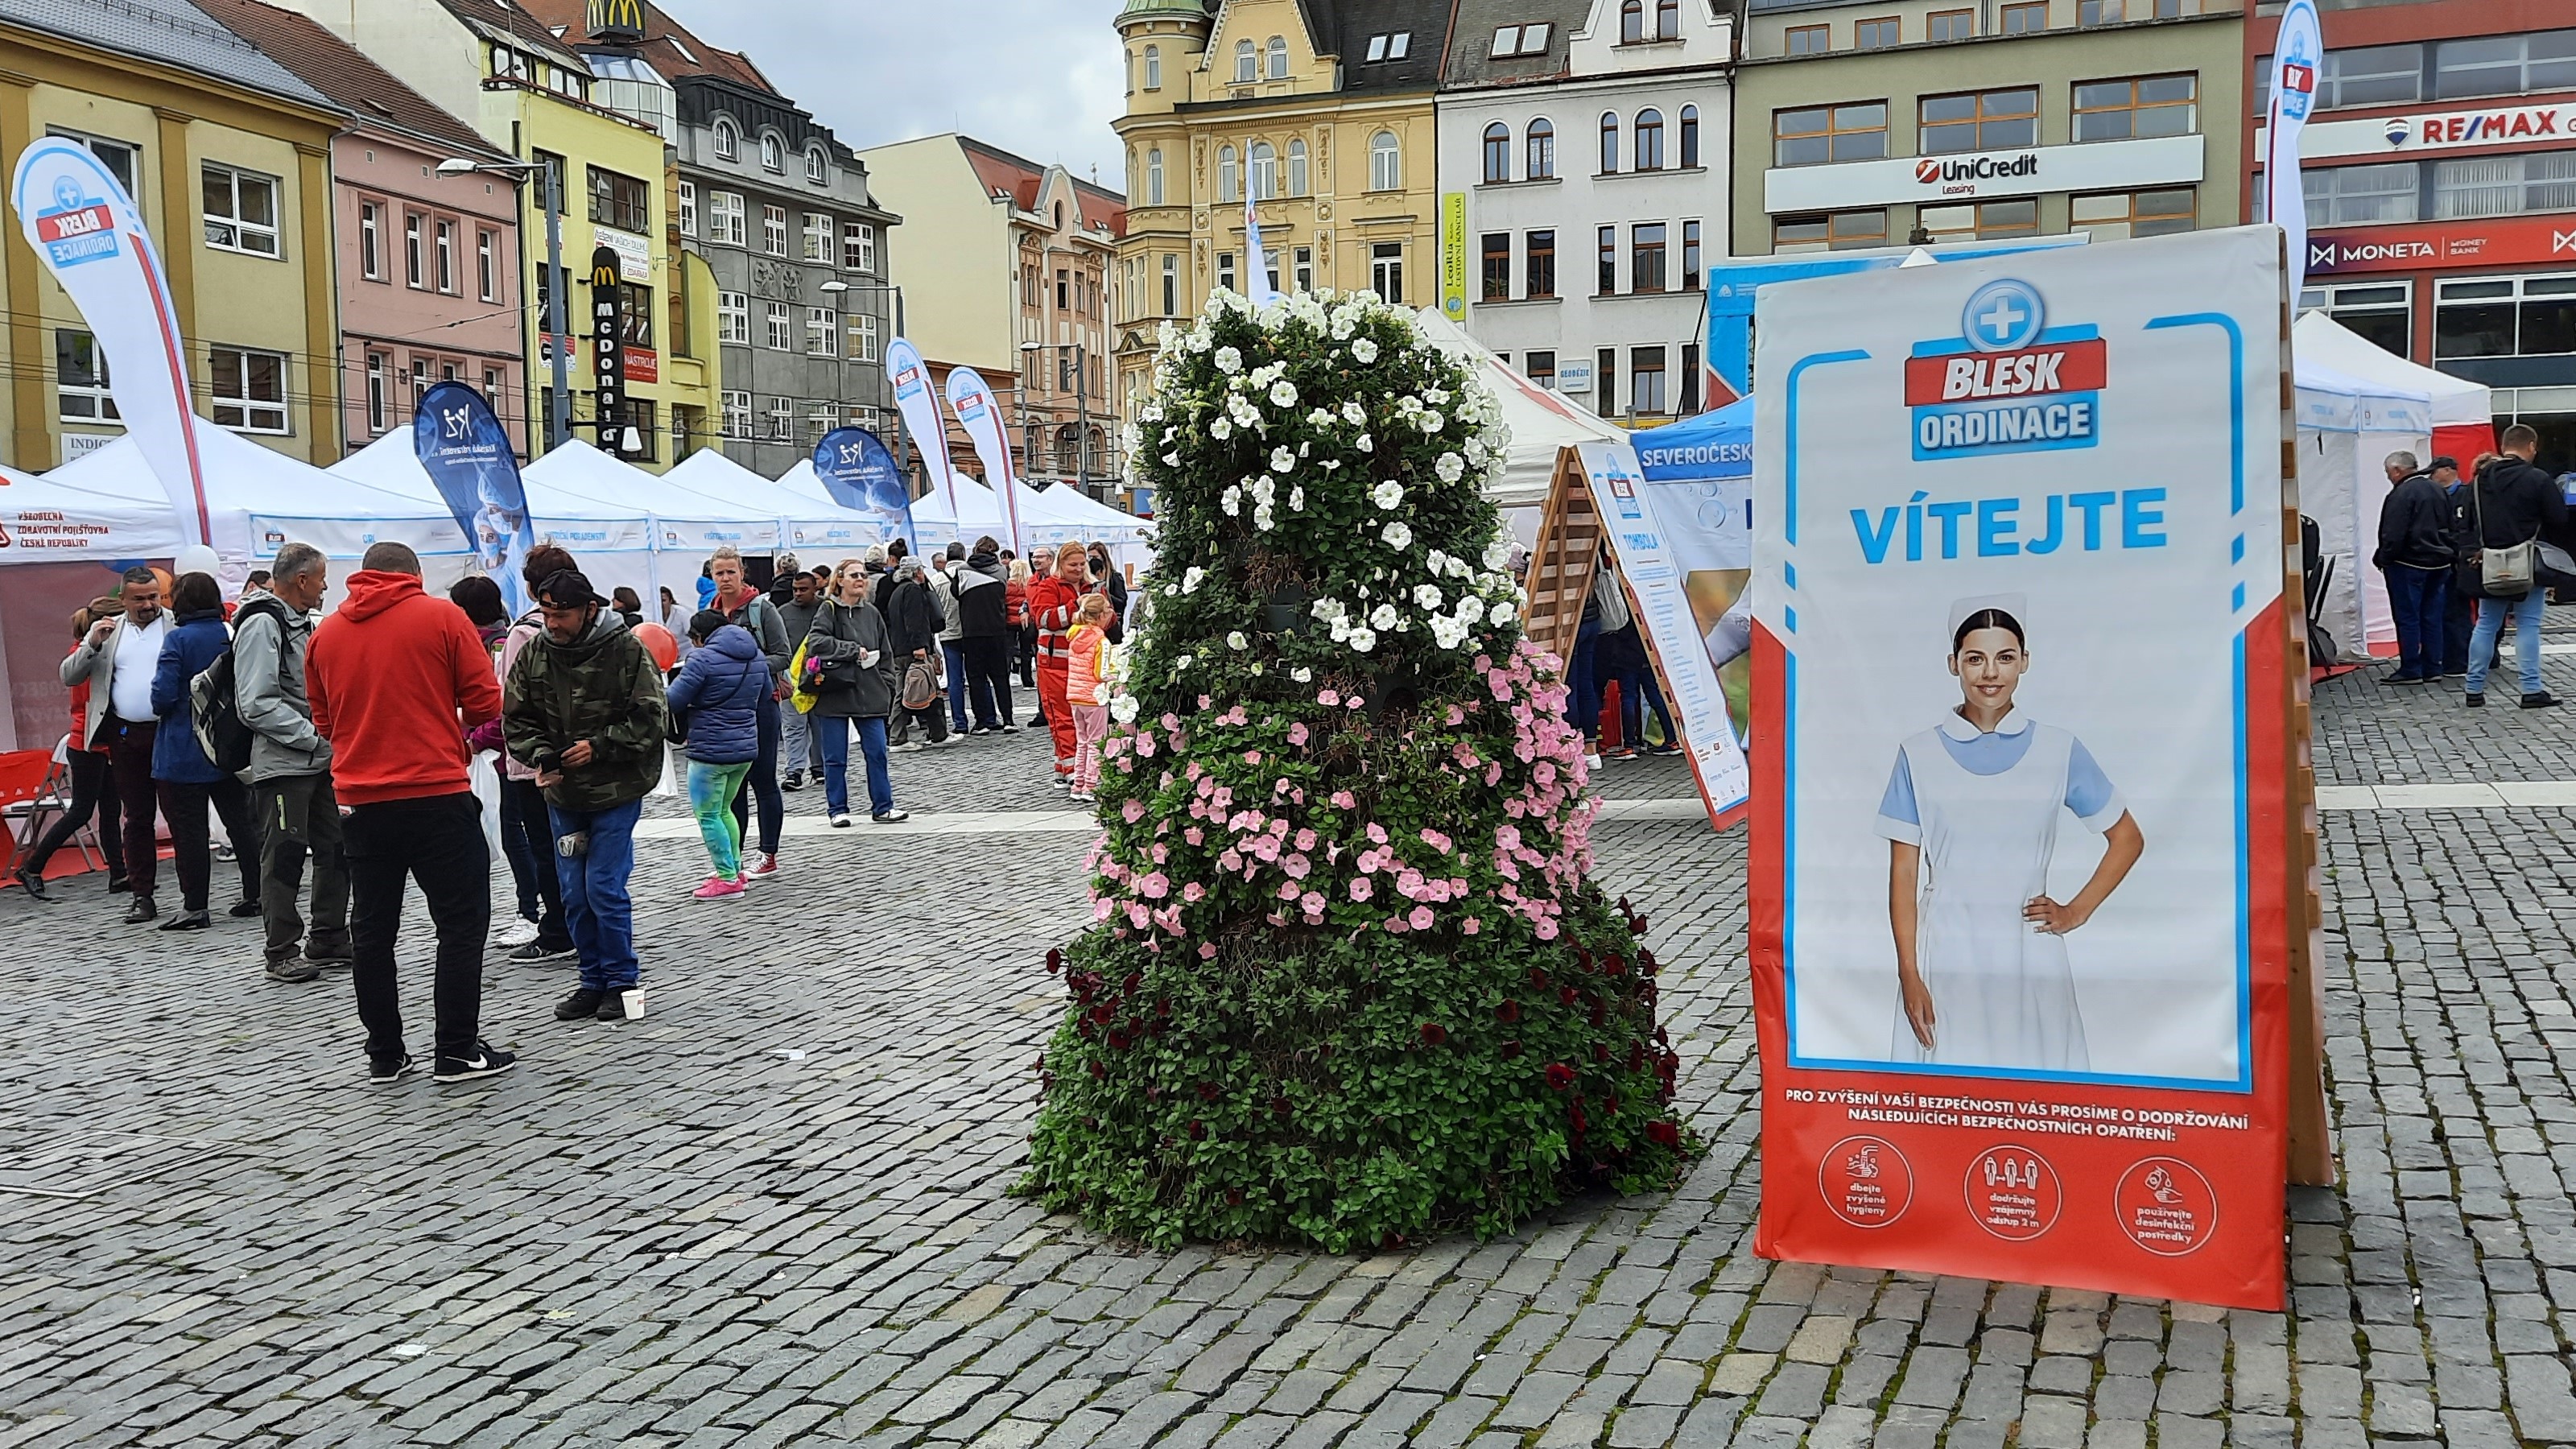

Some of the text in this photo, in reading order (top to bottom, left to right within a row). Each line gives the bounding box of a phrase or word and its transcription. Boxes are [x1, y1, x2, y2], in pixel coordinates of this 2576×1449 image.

[2423, 110, 2557, 143] RE/MAX
[1942, 154, 2037, 181] UniCredit
[1942, 184, 1975, 195] Leasing
[2450, 238, 2487, 247] MONEY
[2343, 242, 2435, 262] MONETA
[2450, 246, 2480, 255] BANK
[1446, 244, 1454, 287] LeoRia
[625, 353, 657, 369] NÁSTROJE
[1560, 367, 1590, 378] GEODÉZIE
[1942, 352, 2066, 401] BLESK
[1920, 403, 2091, 449] ORDINACE
[1642, 442, 1752, 467] SEVEROČESK
[18, 511, 64, 522] VŠEOBECNÁ
[17, 523, 109, 535] ZDRAVOTNÍ POJIŠŤOVNA
[1850, 487, 2167, 564] VÍTEJTE
[20, 536, 89, 547] ČESKÉ REPUBLIKY
[1623, 533, 1660, 551] TOMBOLA
[1785, 1089, 2248, 1130] PRO ZVÝŠENÍ VAŠÍ BEZPEČNOSTI VÁS PROSÍME O DODRŽOVÁNÍ
[1848, 1106, 2176, 1141] NÁSLEDUJÍCÍCH BEZPEČNOSTNÍCH OPATŘENÍ:
[1850, 1183, 1881, 1194] dbejte
[1846, 1194, 1886, 1204] zvýšené
[1989, 1193, 2036, 1206] dodržujte
[1847, 1203, 1885, 1216] hygieny
[1989, 1205, 2036, 1218] vzájemný
[2136, 1207, 2192, 1221] používejte
[1986, 1215, 2019, 1228] odstup
[2021, 1218, 2028, 1227] 2
[2135, 1217, 2195, 1232] desinfekční
